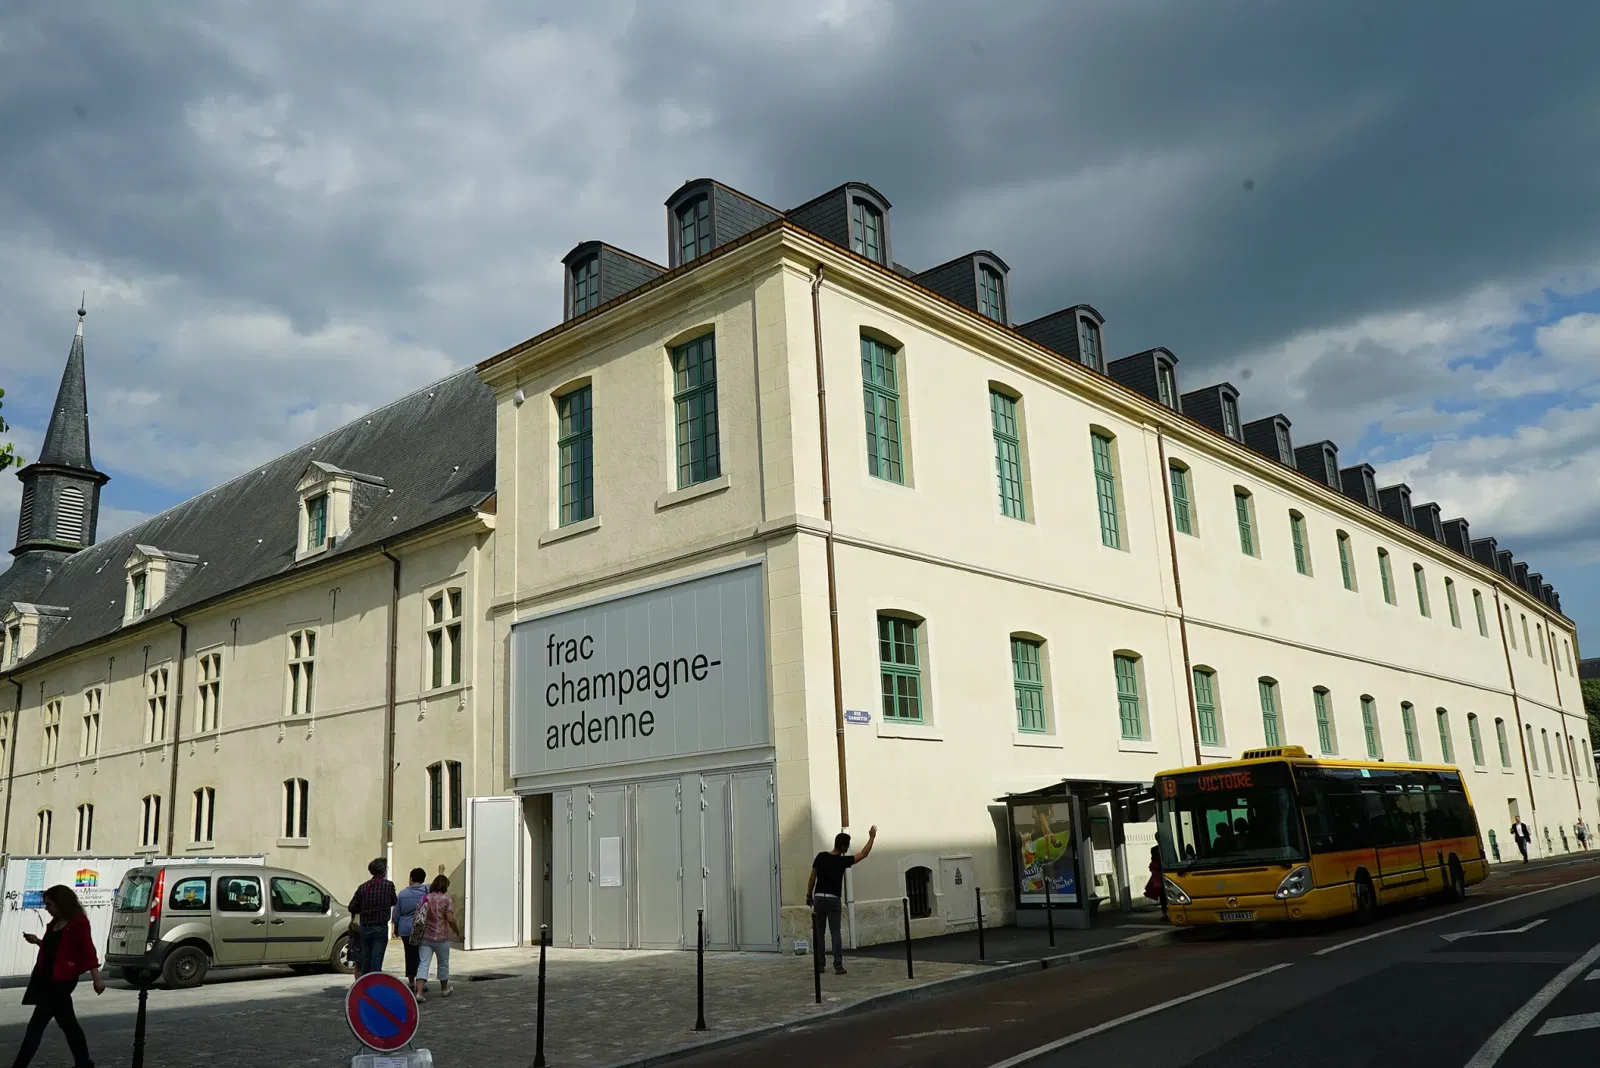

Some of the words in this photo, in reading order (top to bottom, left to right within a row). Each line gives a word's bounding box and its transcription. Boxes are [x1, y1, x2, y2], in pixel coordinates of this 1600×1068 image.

[546, 633, 594, 667] frac
[546, 653, 721, 707] champagne-
[546, 710, 655, 750] ardenne
[1198, 772, 1254, 791] VICTOIRE
